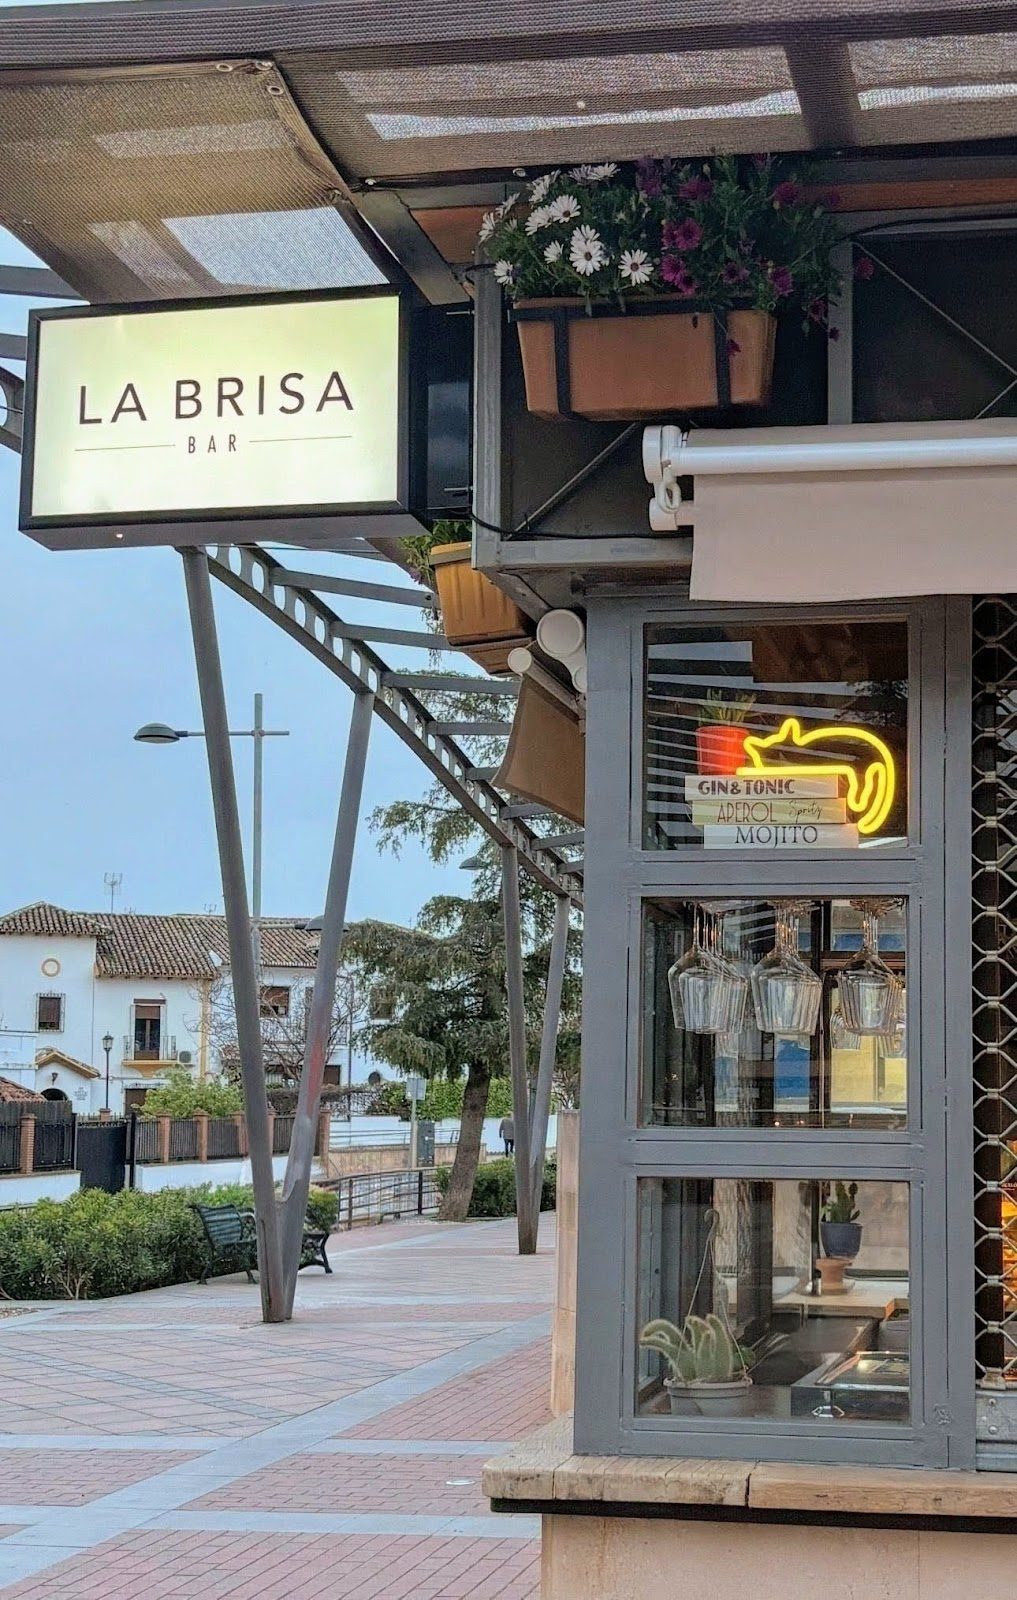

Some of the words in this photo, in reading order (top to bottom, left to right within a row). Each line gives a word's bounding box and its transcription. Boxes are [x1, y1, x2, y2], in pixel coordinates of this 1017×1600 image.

[79, 383, 147, 424] LA
[175, 371, 354, 419] BRISA
[188, 434, 237, 454] BAR
[698, 779, 795, 795] GIN&TONIC
[718, 802, 777, 823] APEROL
[736, 826, 818, 848] MOJITO
